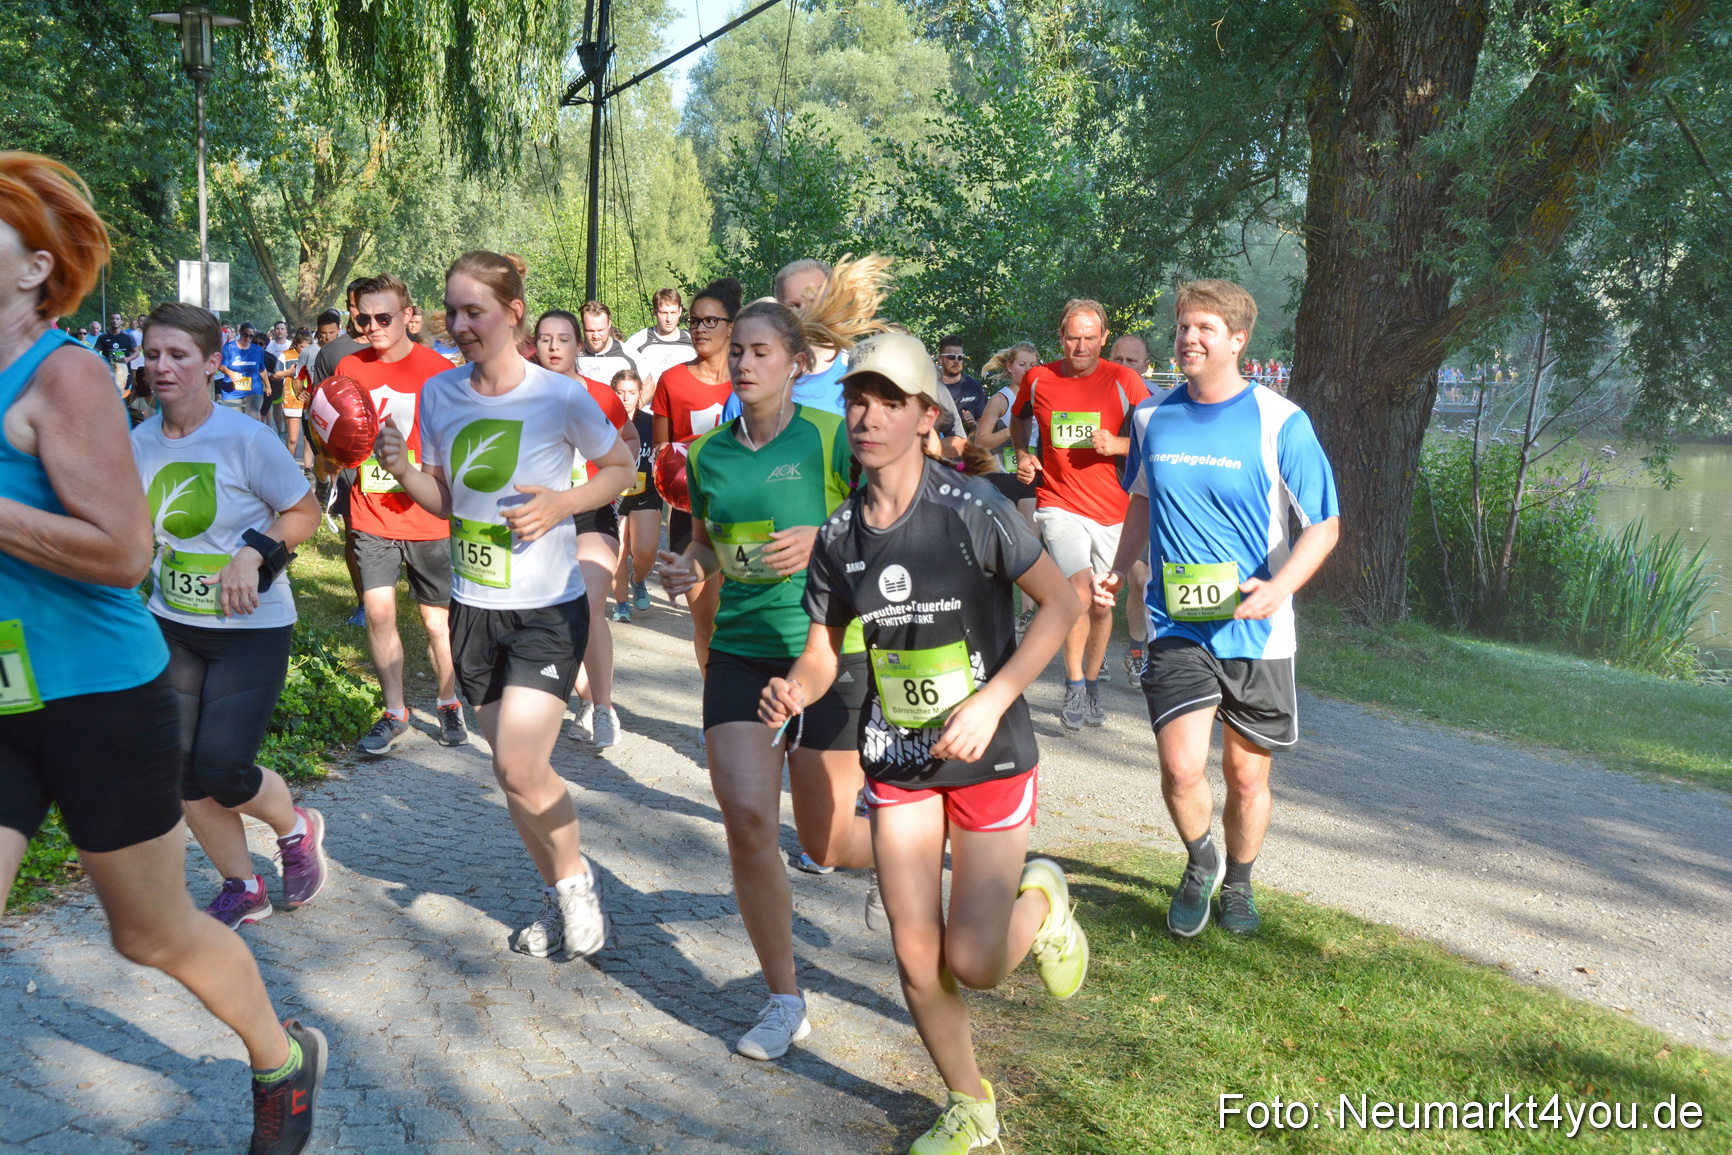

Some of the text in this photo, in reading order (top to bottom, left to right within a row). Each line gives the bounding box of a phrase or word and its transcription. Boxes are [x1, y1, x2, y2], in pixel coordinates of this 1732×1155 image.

[1057, 425, 1093, 438] 1158
[1149, 452, 1242, 470] energiegeladen
[371, 466, 396, 480] 42
[767, 463, 801, 480] AOK
[458, 540, 492, 567] 155
[735, 545, 749, 566] 4
[845, 561, 866, 573] JAKO
[168, 570, 210, 597] 133
[1178, 585, 1221, 605] 210
[903, 679, 939, 706] 86
